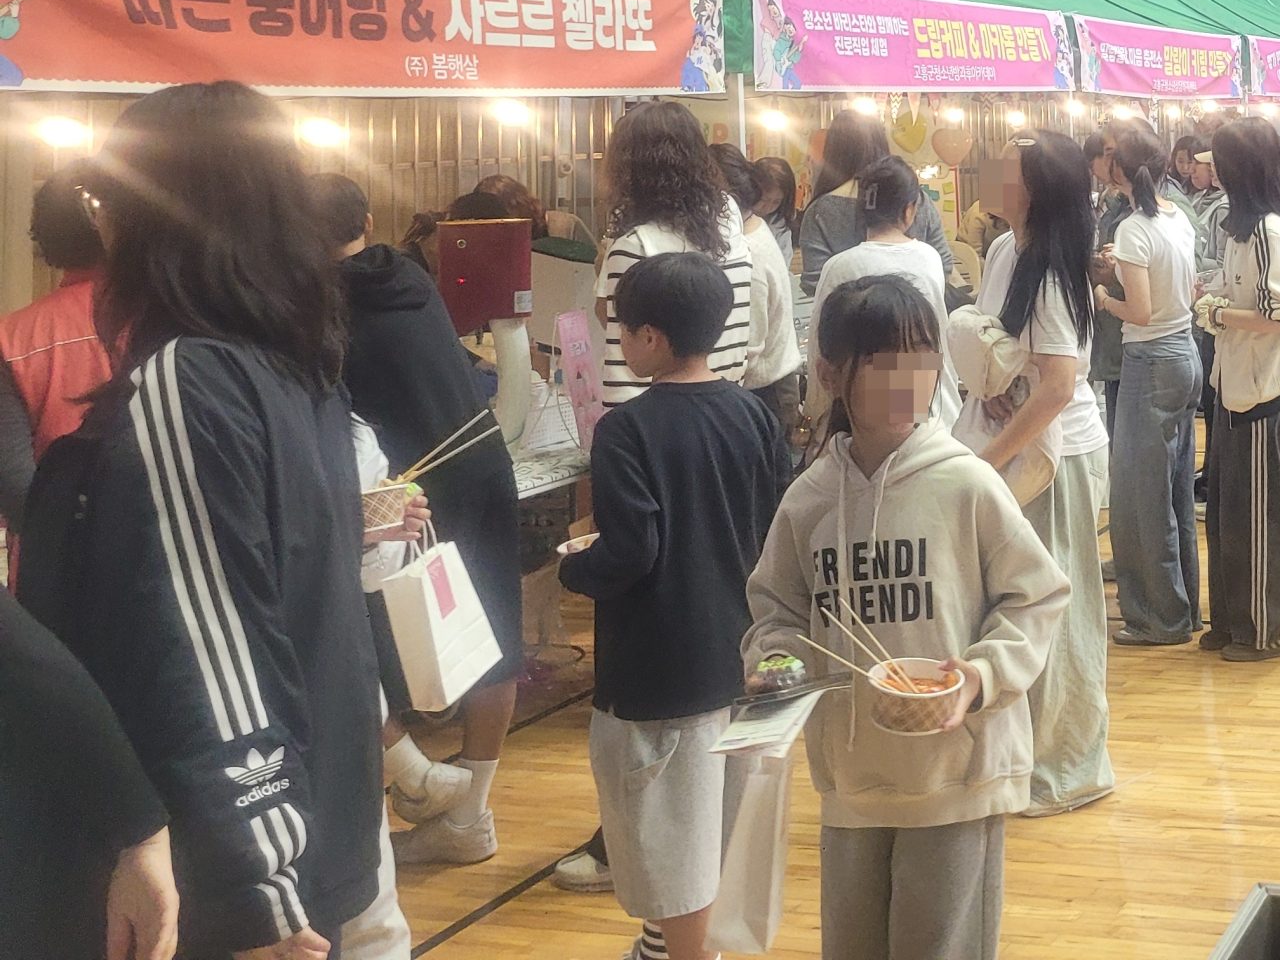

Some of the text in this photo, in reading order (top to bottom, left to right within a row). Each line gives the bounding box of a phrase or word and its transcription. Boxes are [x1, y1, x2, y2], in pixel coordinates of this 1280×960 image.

[803, 9, 833, 31] 청소년
[832, 12, 877, 34] 바리스타와
[834, 35, 888, 56] 진로직업 체험
[913, 18, 1051, 62] 드립커피 & 마카롱 만들기
[405, 54, 479, 80] (주) 봄햇살
[1163, 44, 1191, 77] 말랑이
[1191, 48, 1208, 78] 키링
[235, 778, 290, 807] adidas
